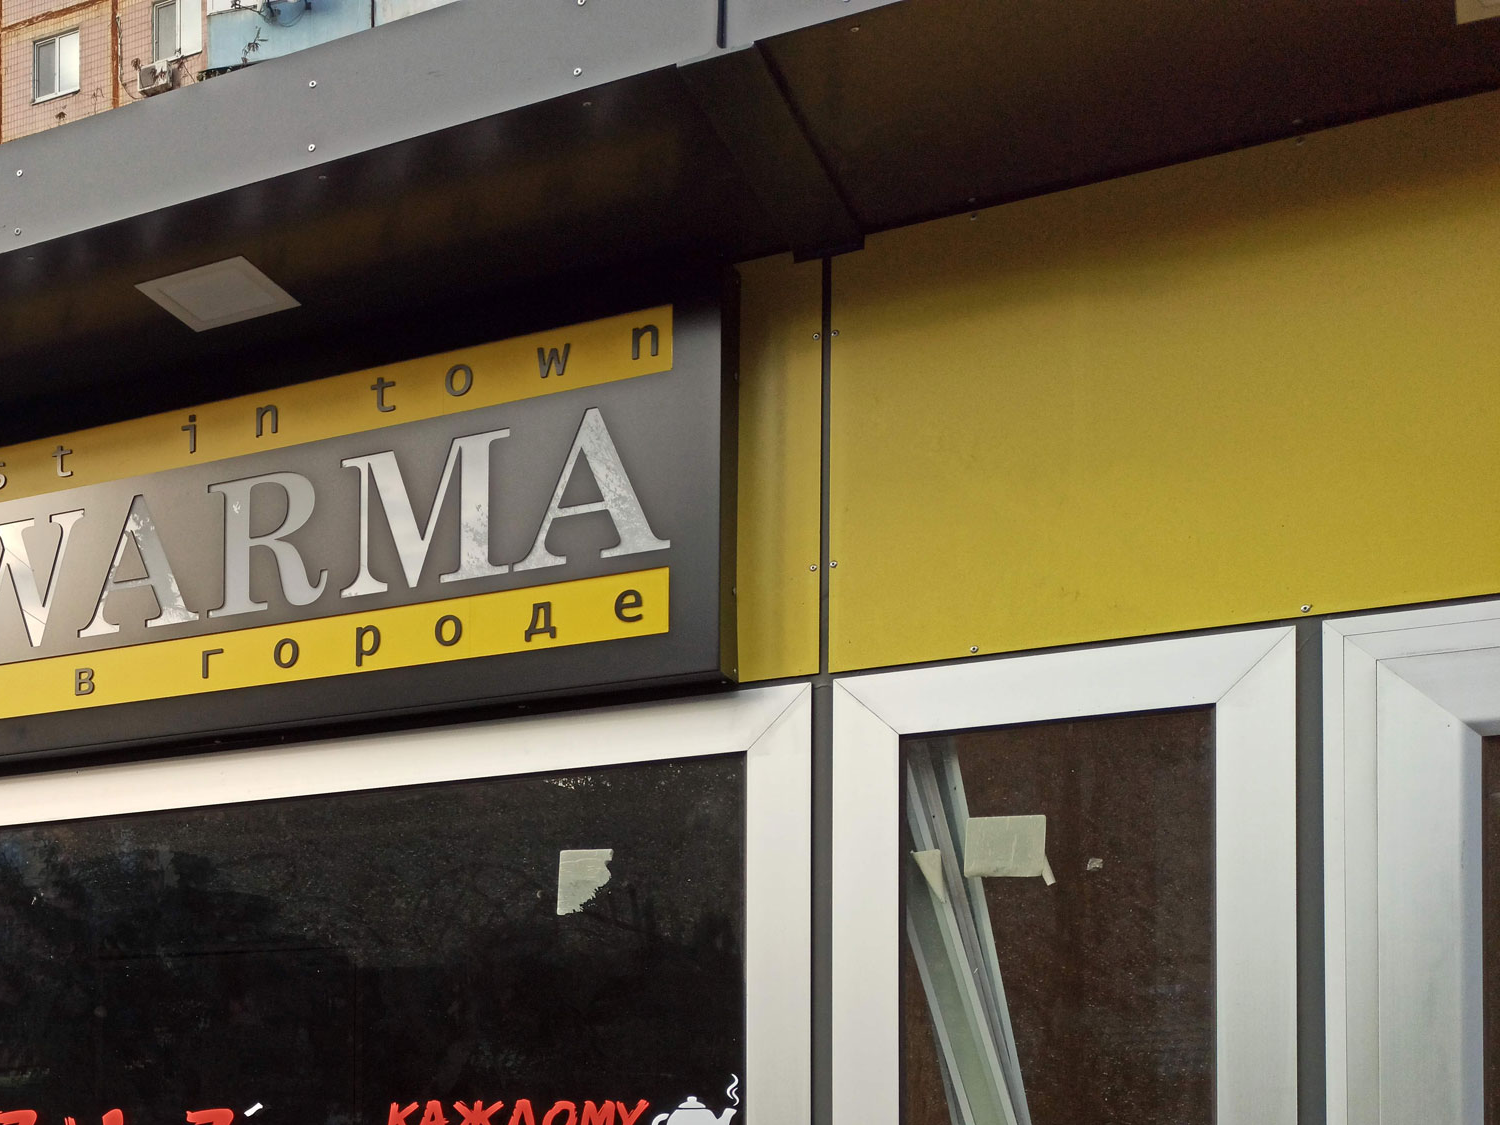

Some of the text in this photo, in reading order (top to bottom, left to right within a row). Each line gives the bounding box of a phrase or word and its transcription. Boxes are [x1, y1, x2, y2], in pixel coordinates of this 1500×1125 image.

[181, 403, 279, 454] in
[370, 323, 660, 413] town
[74, 667, 95, 696] в
[201, 588, 644, 680] городе
